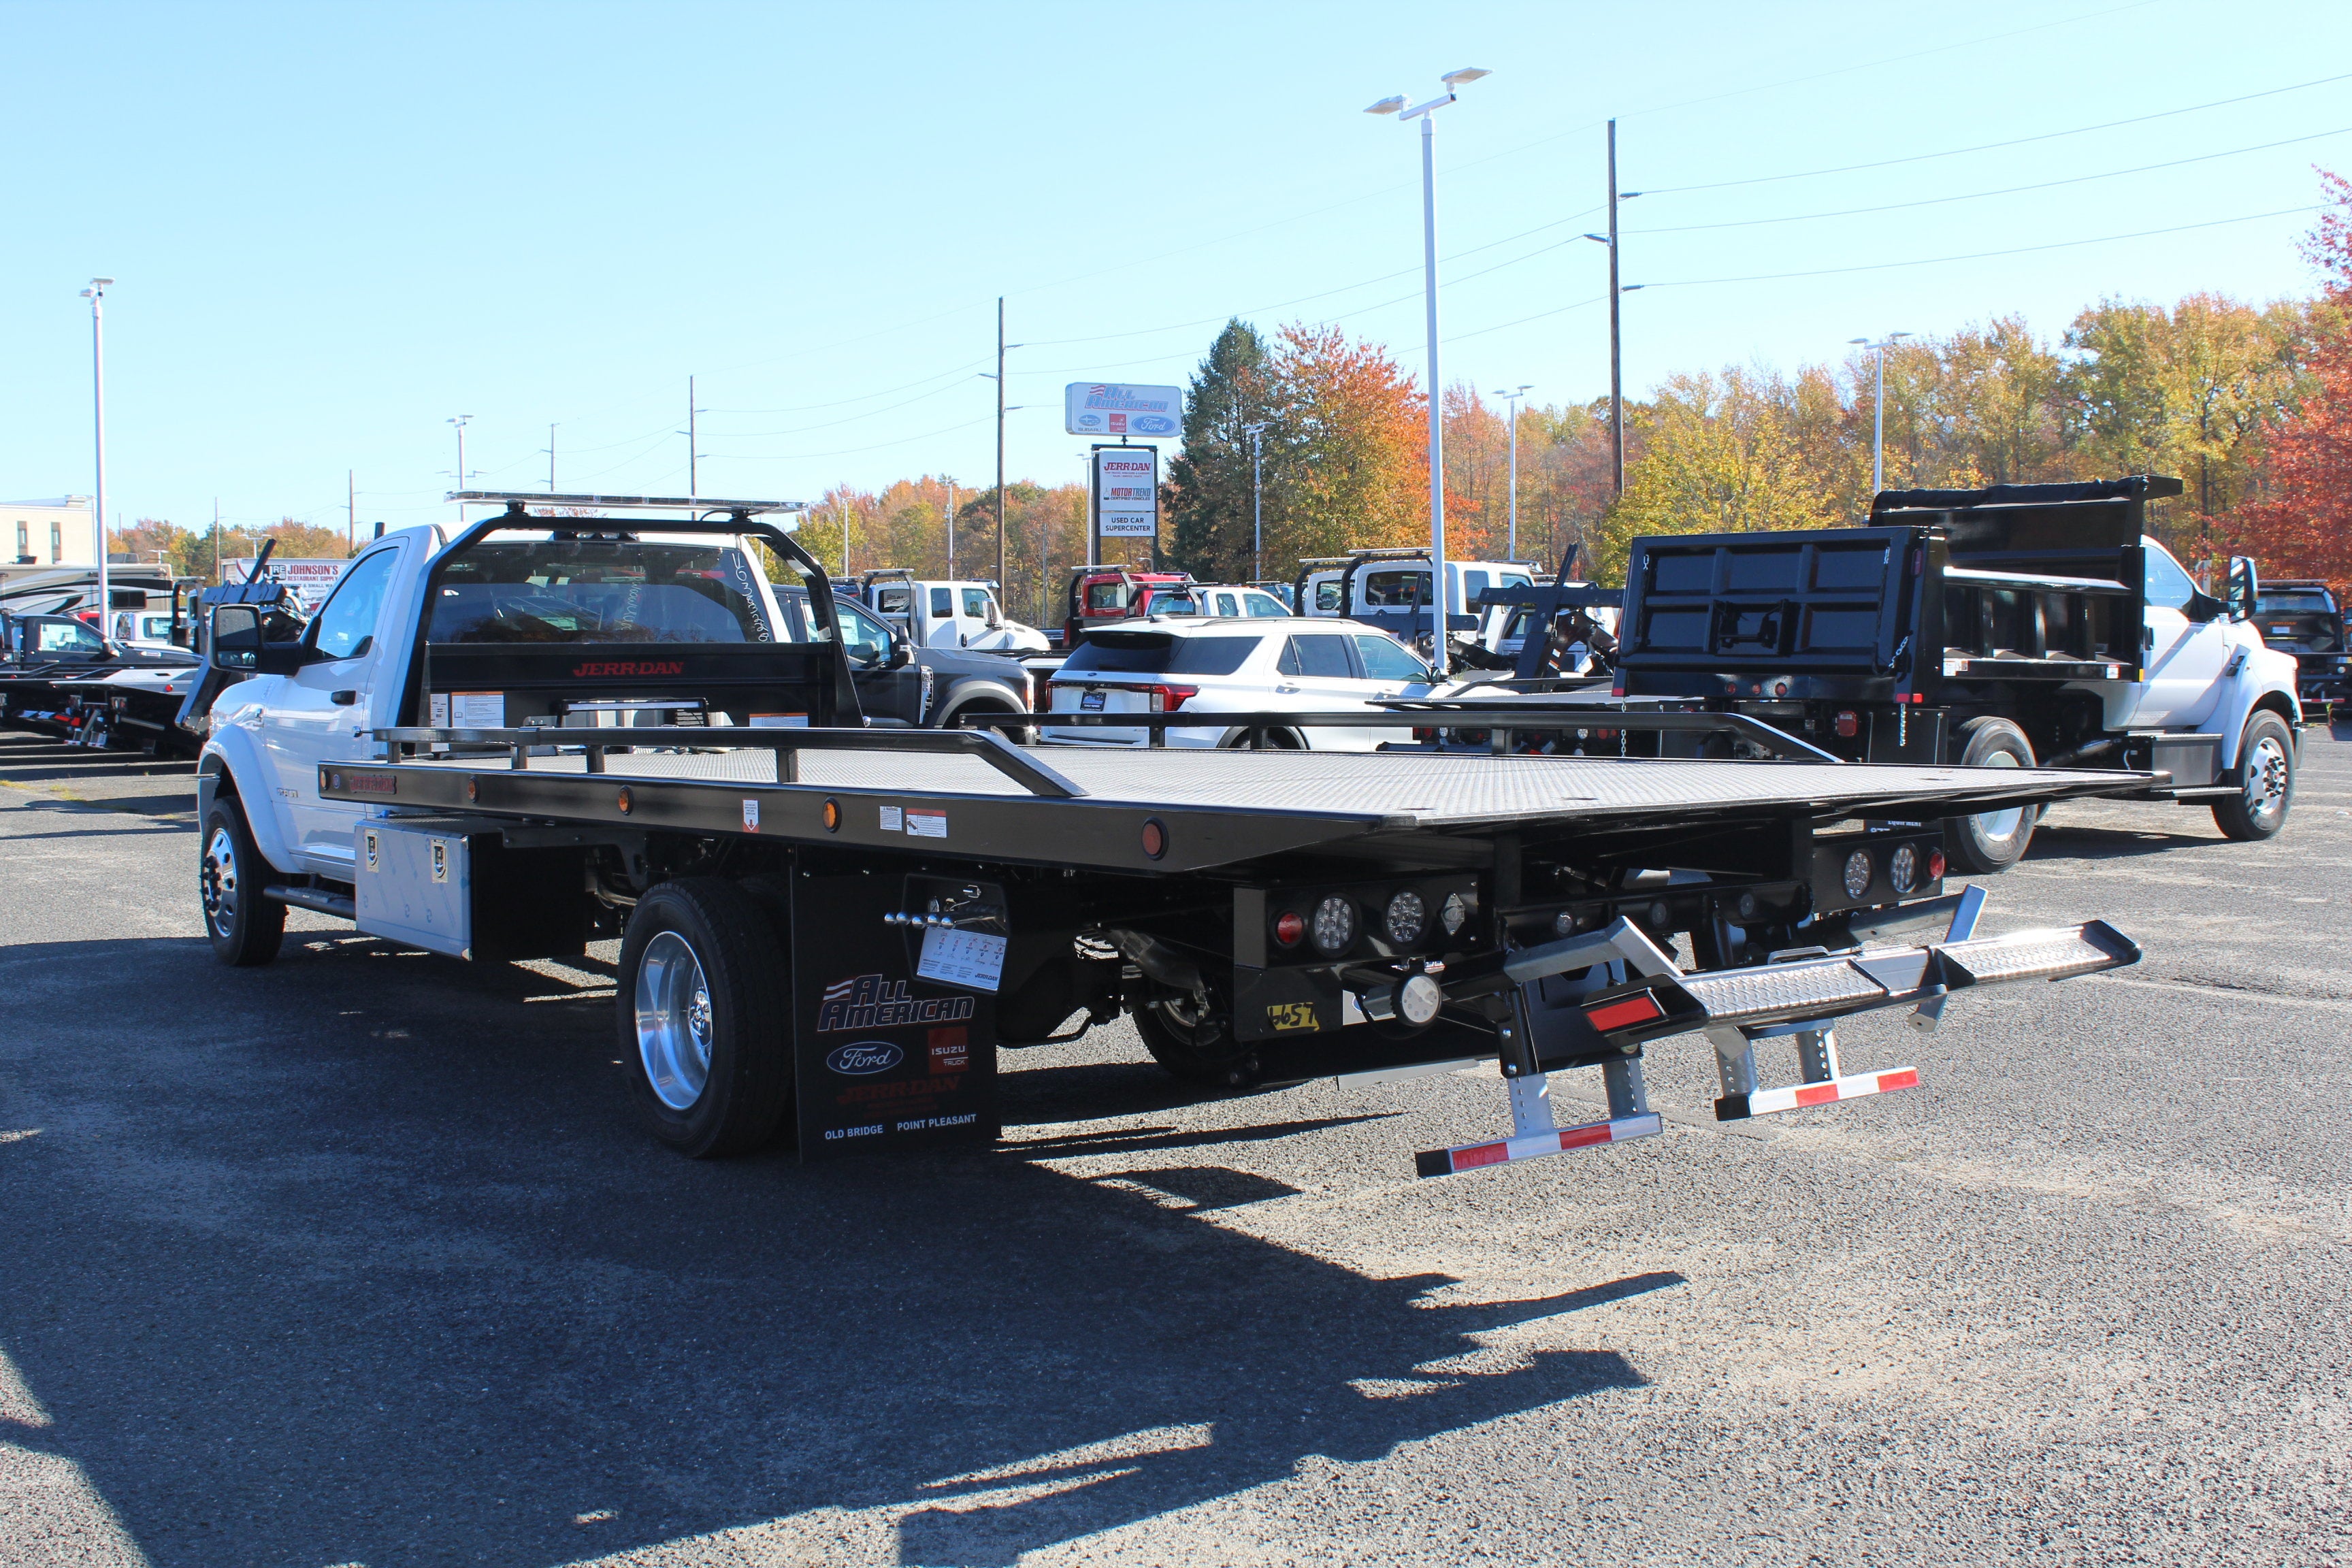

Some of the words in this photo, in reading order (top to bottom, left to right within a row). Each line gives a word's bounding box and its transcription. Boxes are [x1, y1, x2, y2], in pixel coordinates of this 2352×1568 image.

[1141, 417, 1166, 431] Ford
[288, 565, 339, 576] JOHNSON'S
[932, 1045, 966, 1056] ISUZU
[839, 1046, 892, 1070] Ford
[825, 1129, 844, 1140] OLD
[847, 1124, 883, 1138] BRIDGE
[897, 1120, 926, 1131] POINT
[929, 1113, 977, 1128] PLEASANT
